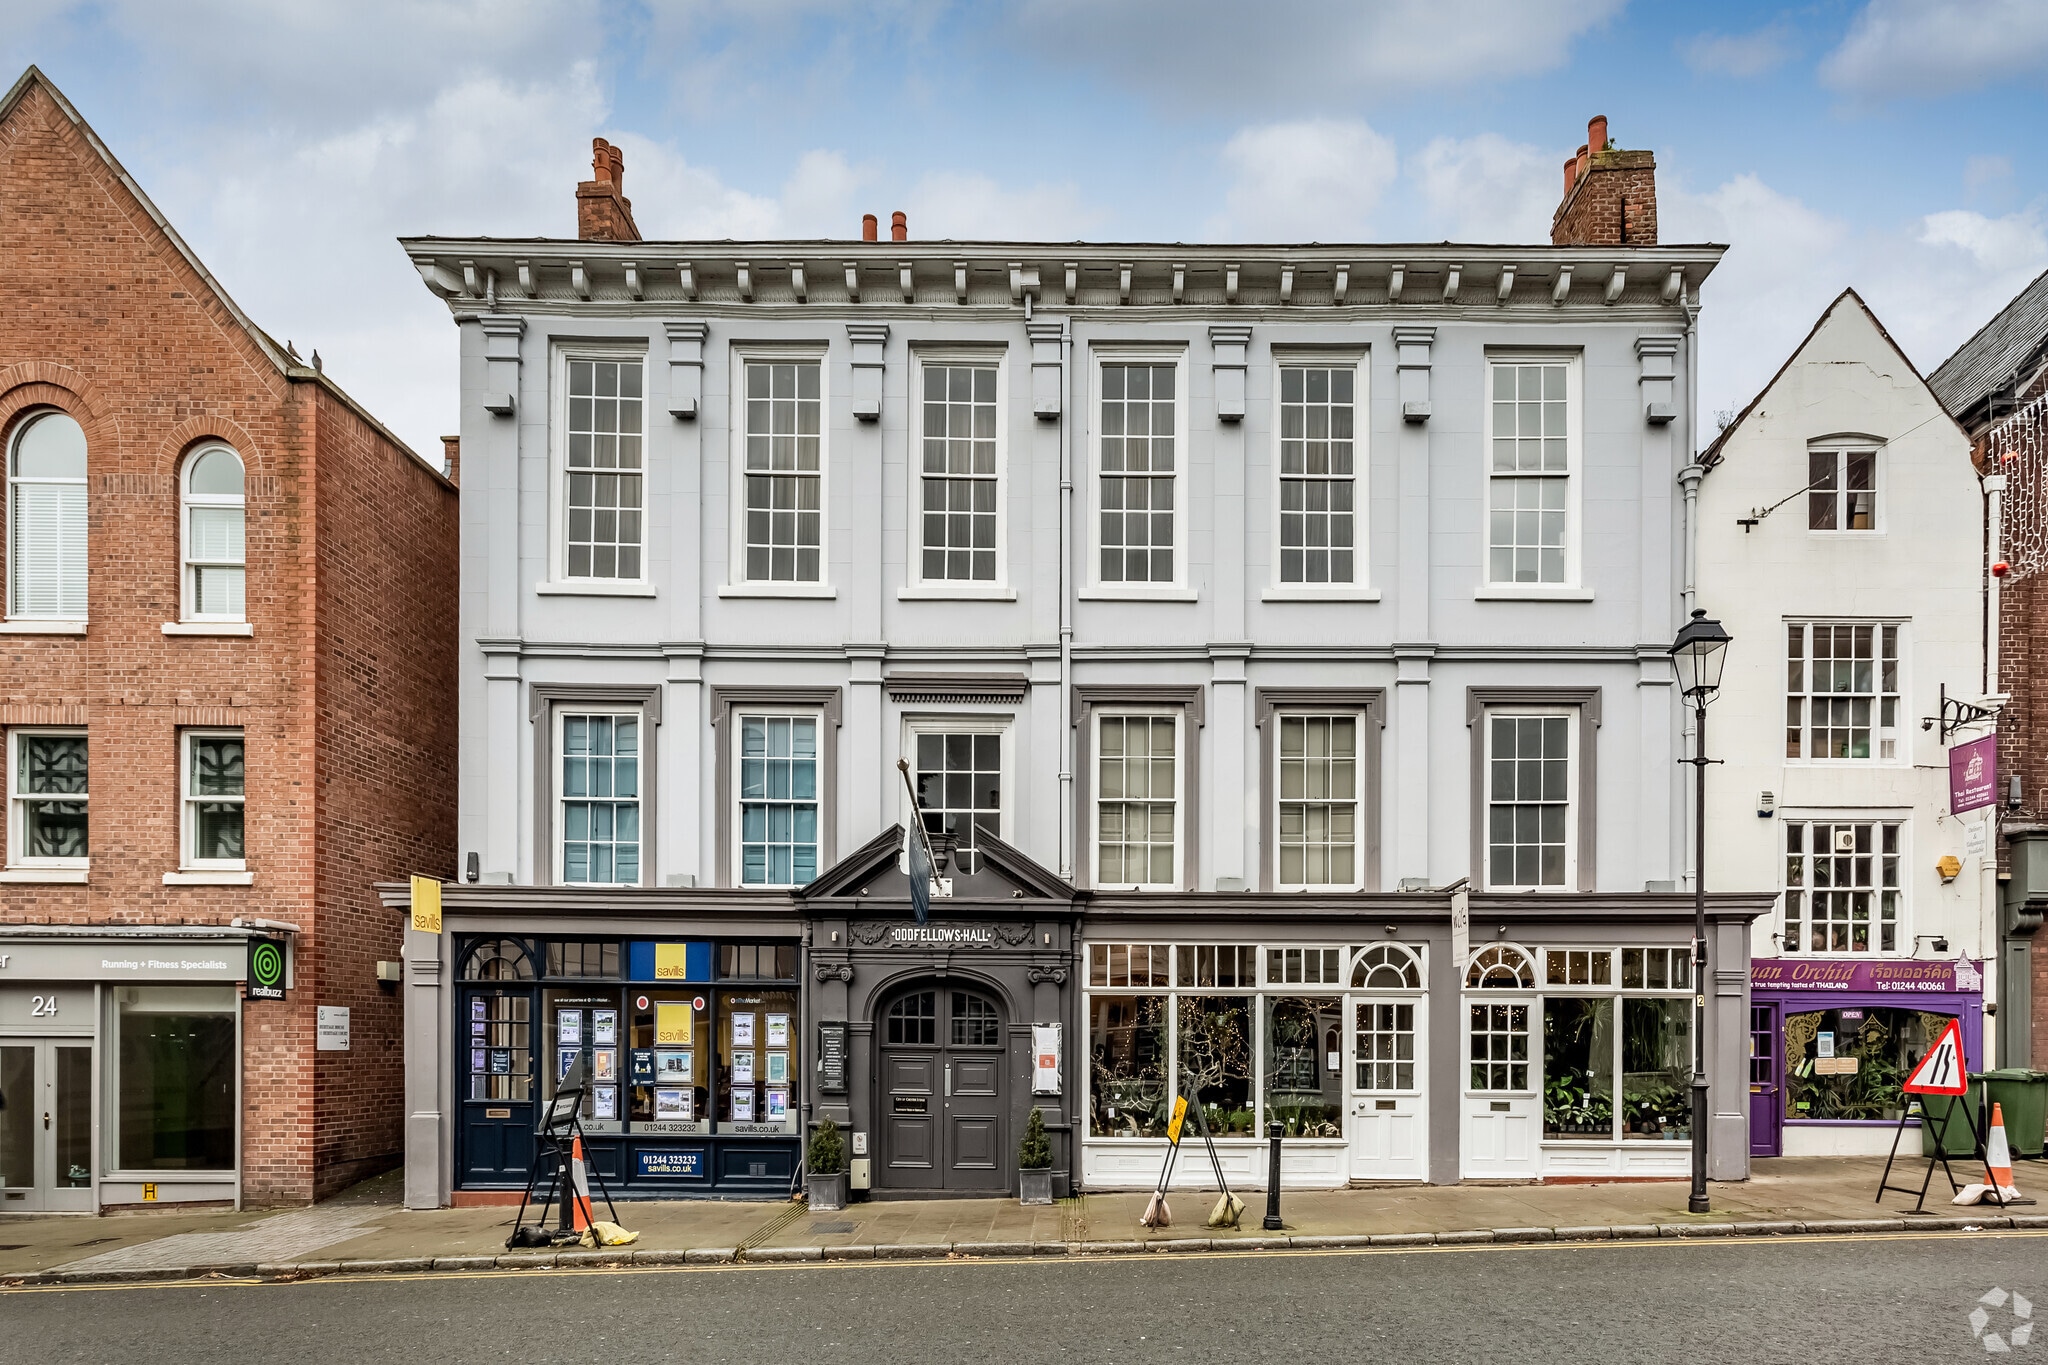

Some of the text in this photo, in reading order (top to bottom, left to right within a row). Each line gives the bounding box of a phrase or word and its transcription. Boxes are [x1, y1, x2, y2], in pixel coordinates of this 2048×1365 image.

[1954, 783, 1992, 798] Thai Restaurant
[414, 914, 441, 931] savills
[101, 959, 138, 970] Running
[148, 960, 179, 969] Fitness
[181, 960, 228, 971] Specialists
[656, 965, 685, 977] savills
[1751, 961, 1861, 981] uan Orchid
[1767, 981, 1791, 990] tempting
[1808, 981, 1815, 989] of
[1815, 981, 1849, 990] THAILAND
[1876, 981, 1946, 991] Tel: 01244 400661
[252, 985, 283, 998] realbuzz
[31, 995, 58, 1017] 24
[1698, 996, 1704, 1006] 2
[1842, 1010, 1861, 1018] OPEN
[659, 1029, 690, 1042] savills
[644, 1123, 697, 1132] 01244 323232
[734, 1124, 780, 1133] savills.co.uk
[642, 1155, 697, 1165] 01244 323232
[647, 1164, 692, 1173] savills.co.uk
